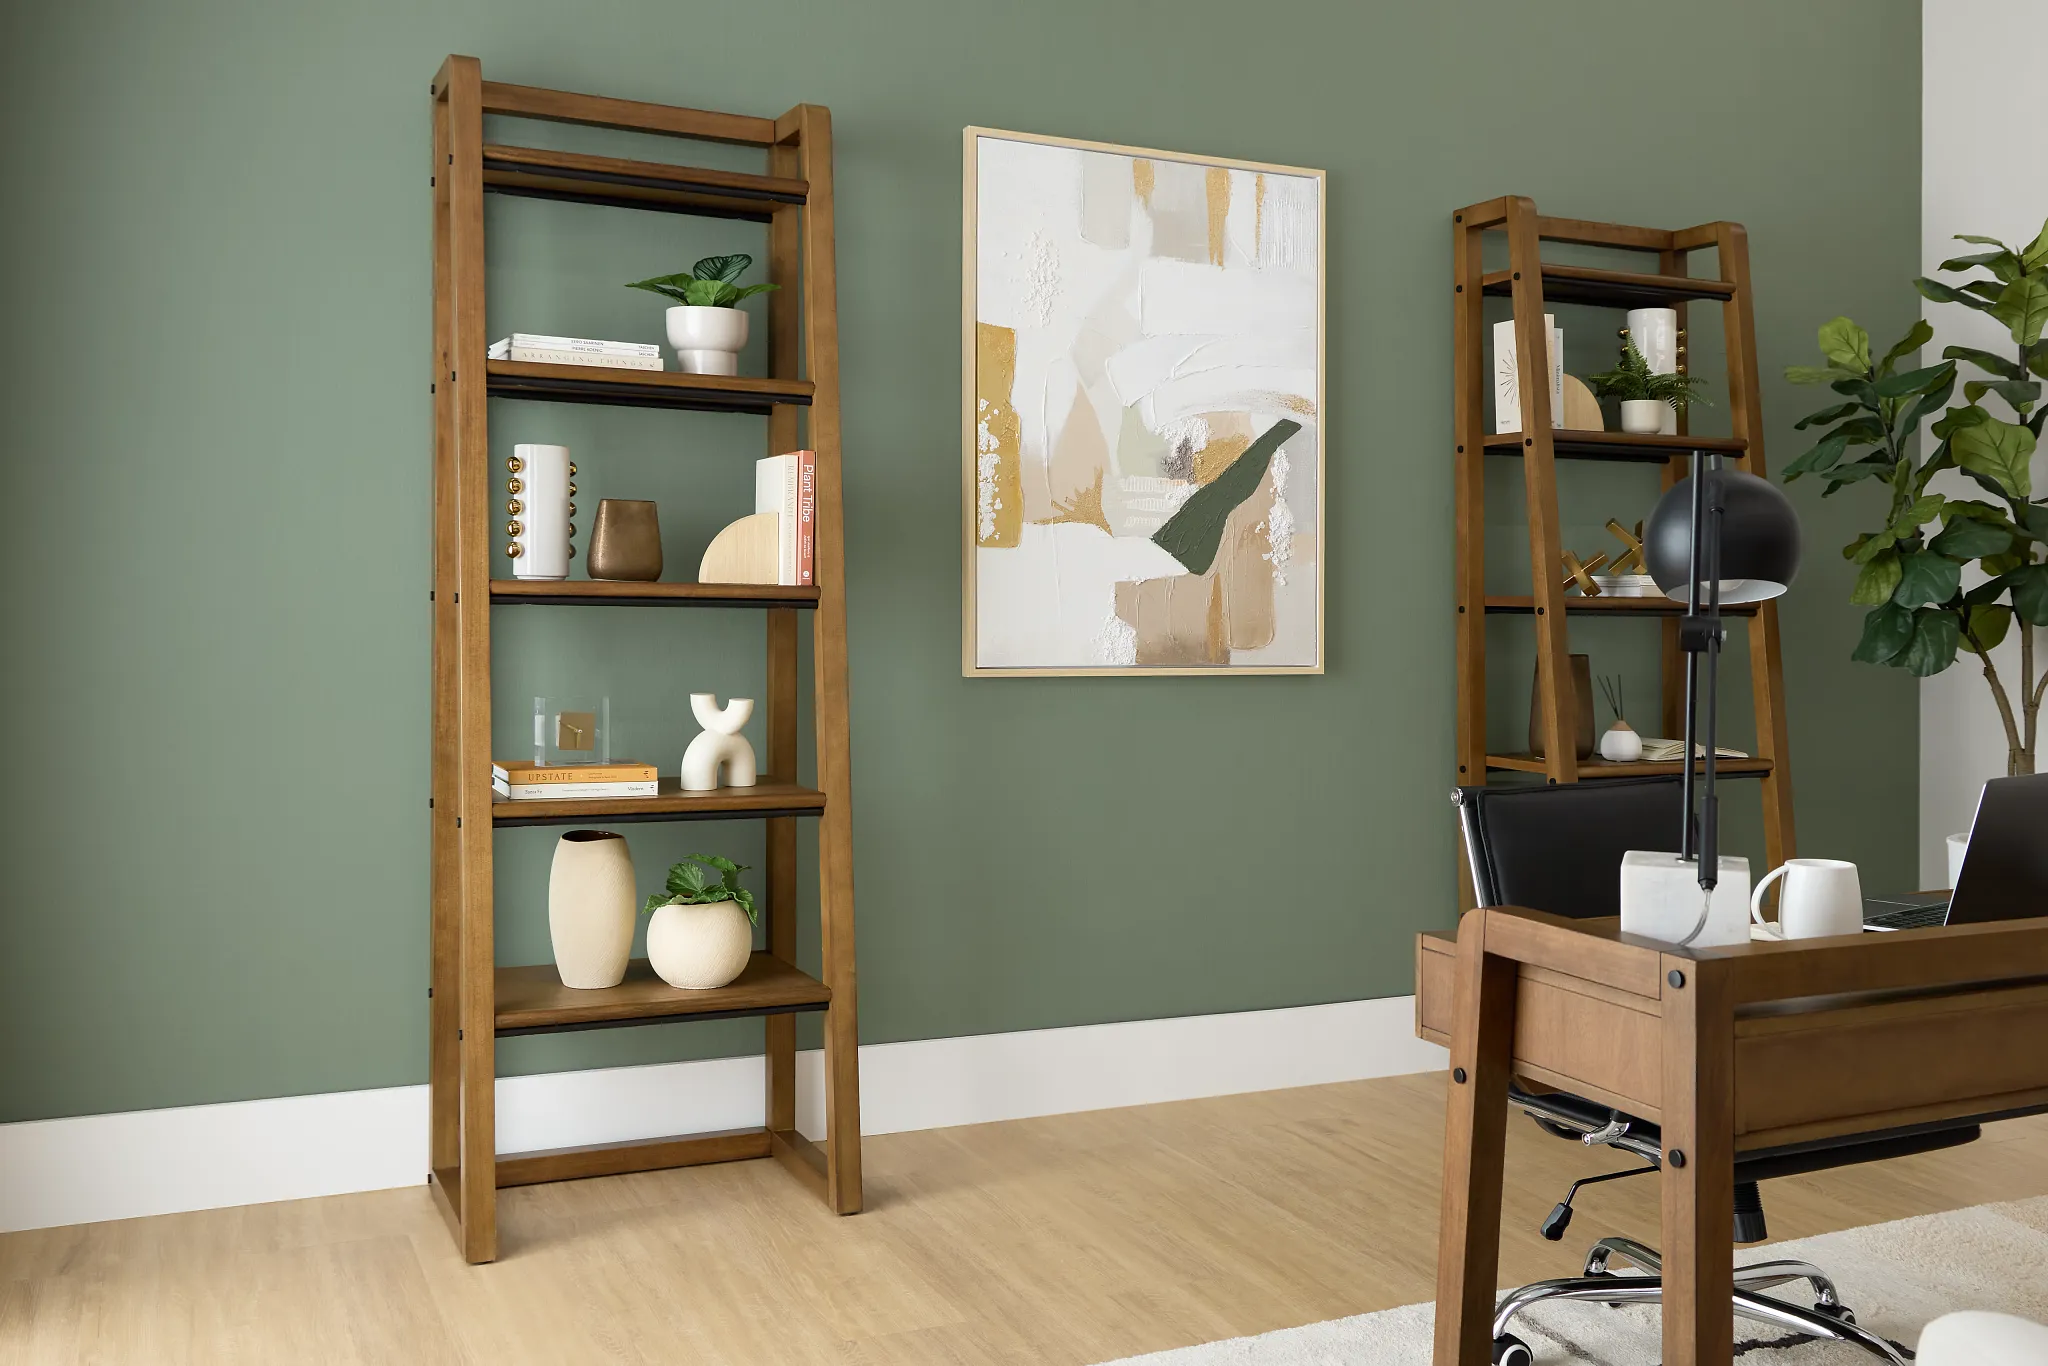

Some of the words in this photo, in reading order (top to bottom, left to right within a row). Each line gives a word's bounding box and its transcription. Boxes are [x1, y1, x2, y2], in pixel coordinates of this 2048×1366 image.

[600, 358, 643, 367] THINGS
[803, 464, 814, 493] Plant
[802, 494, 814, 523] Tribe
[528, 772, 573, 781] UPSTATE
